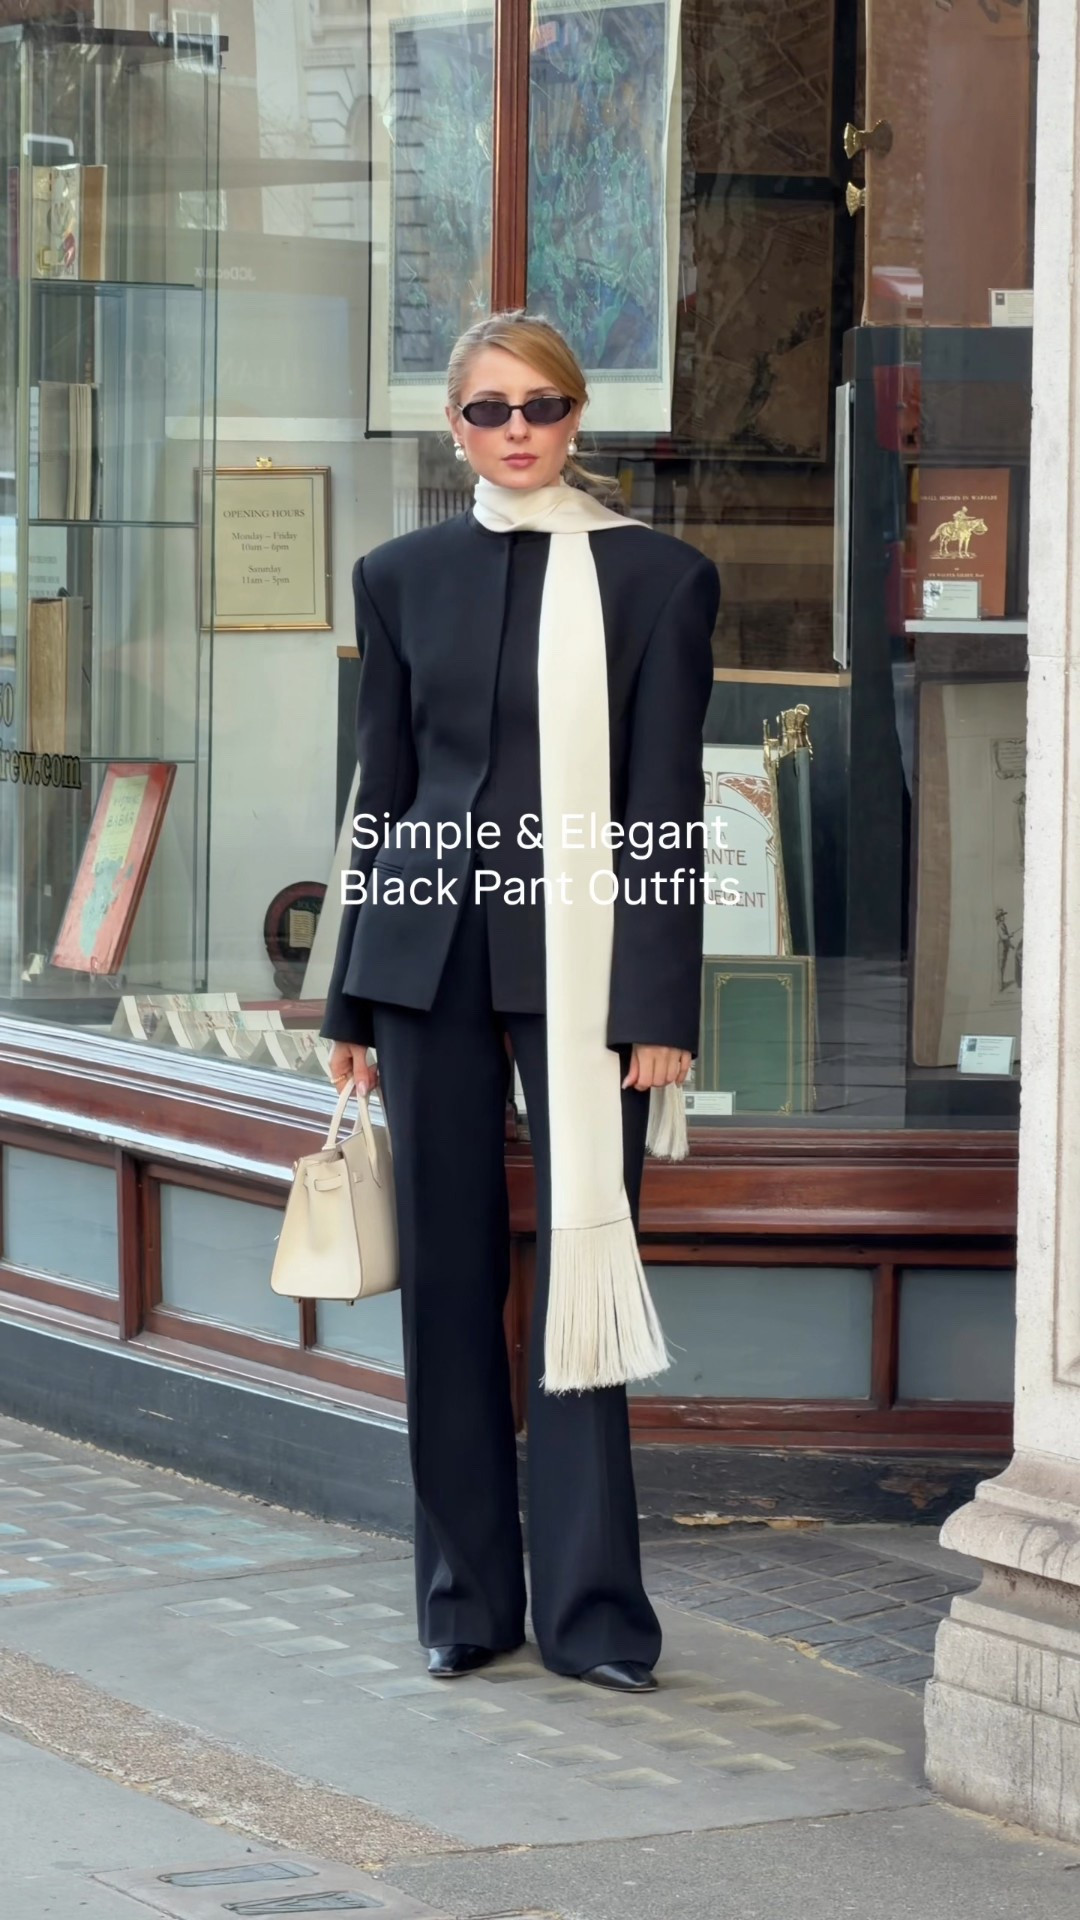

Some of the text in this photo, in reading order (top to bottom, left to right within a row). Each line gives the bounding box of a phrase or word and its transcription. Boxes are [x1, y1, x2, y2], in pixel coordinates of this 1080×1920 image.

[223, 509, 305, 518] OPENING HOURS
[231, 532, 263, 542] Monday
[273, 531, 297, 541] Friday
[241, 543, 262, 551] 10am
[271, 543, 289, 552] 6pm
[248, 564, 281, 574] Saturday
[242, 576, 263, 584] 11am
[272, 575, 290, 586] 5pm
[0, 737, 82, 790] rew.com
